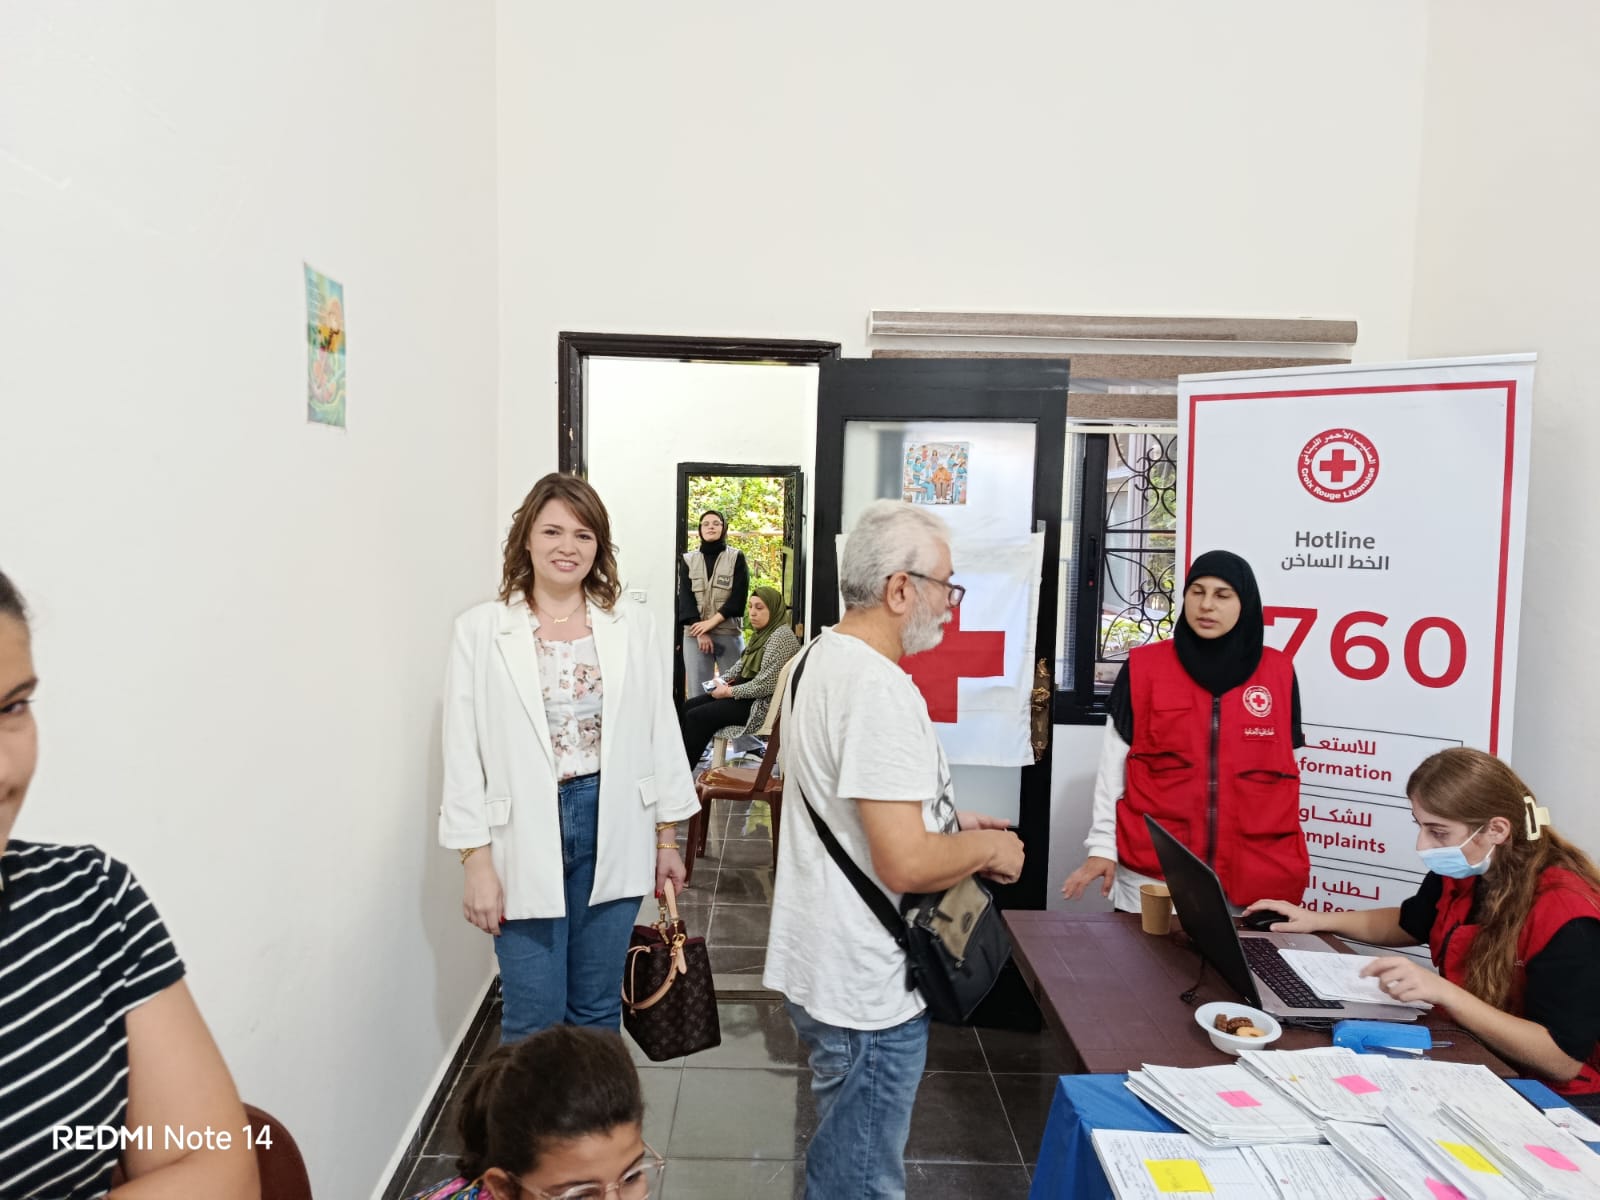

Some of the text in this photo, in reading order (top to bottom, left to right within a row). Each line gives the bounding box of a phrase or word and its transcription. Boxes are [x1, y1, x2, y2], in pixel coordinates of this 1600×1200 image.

[1301, 467, 1376, 501] Croix Rouge Libanaise
[1295, 530, 1376, 550] Hotline
[1280, 552, 1390, 571] الخط الساخن
[1263, 605, 1467, 689] 760
[1303, 736, 1376, 756] للاستع
[1297, 756, 1392, 782] formation
[1299, 805, 1372, 828] للشكاو
[1303, 831, 1386, 854] mplaints
[1321, 880, 1380, 901] لطلب
